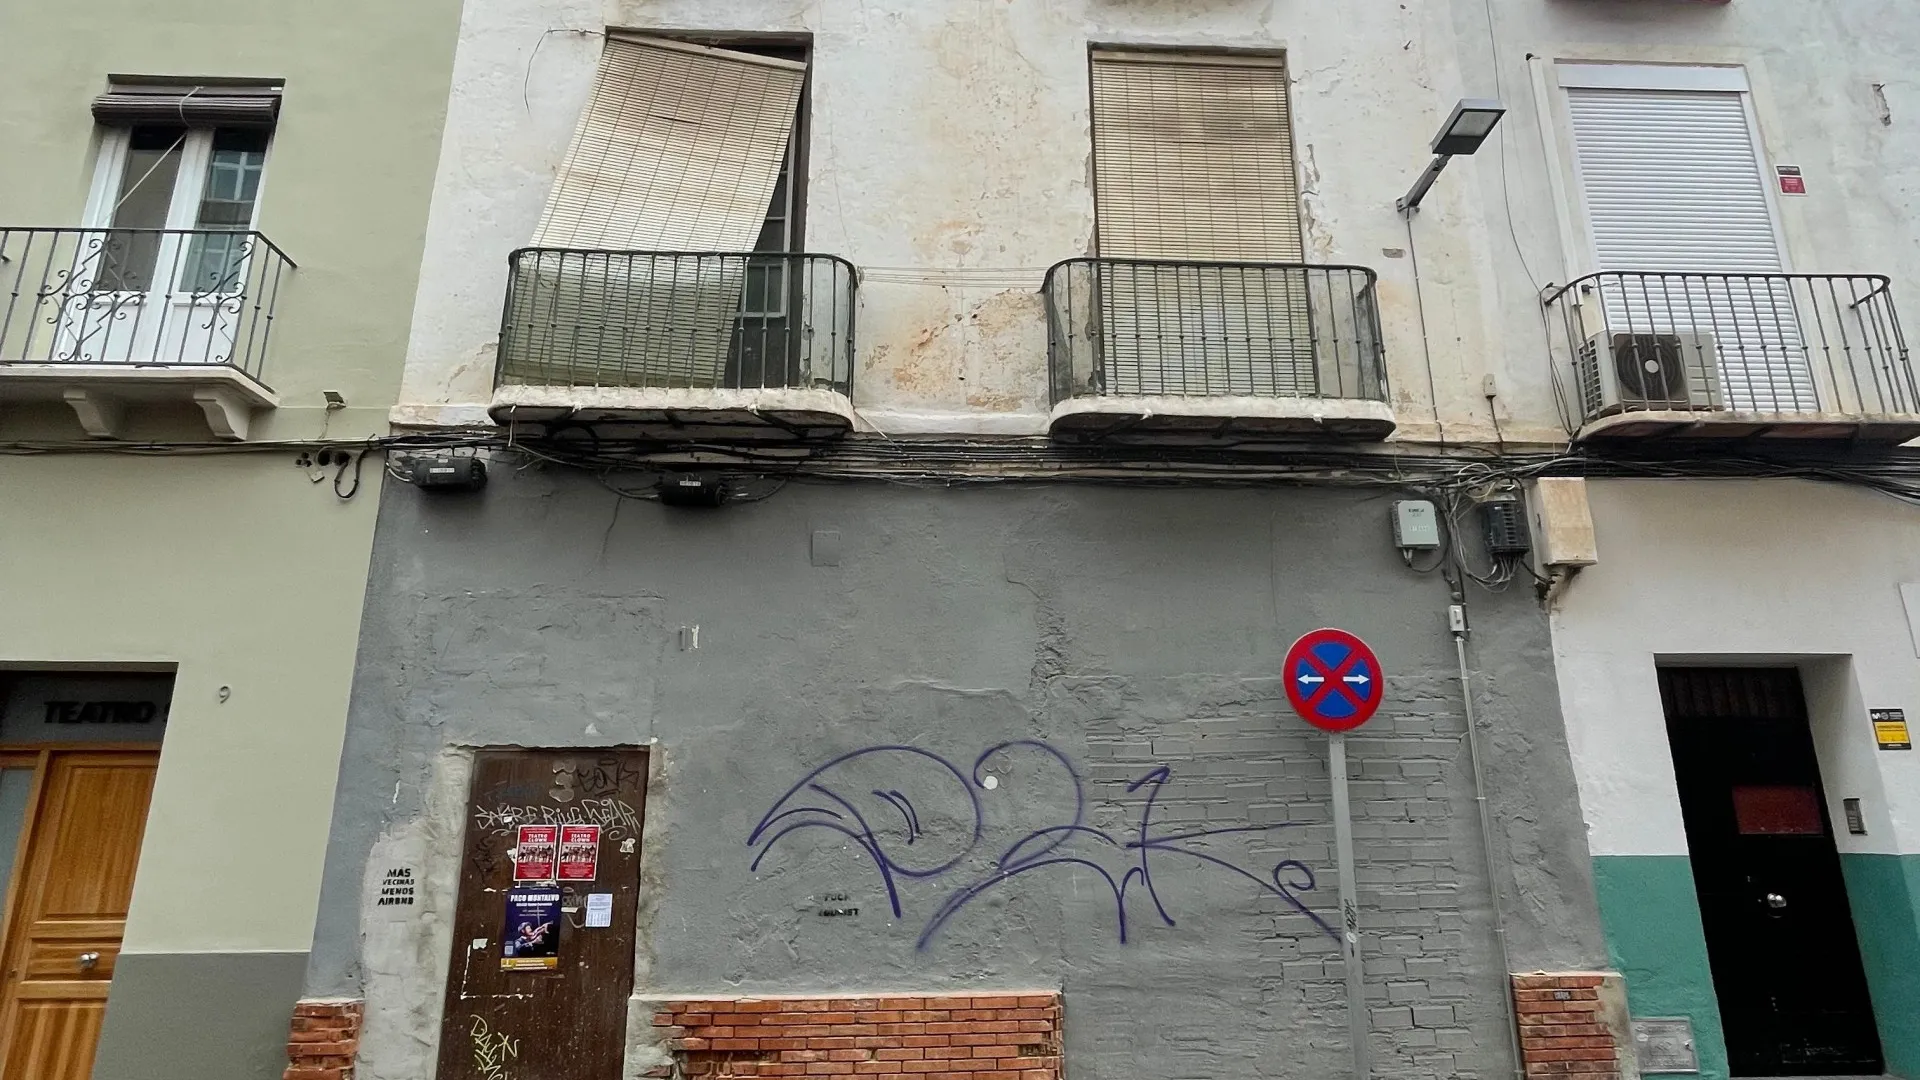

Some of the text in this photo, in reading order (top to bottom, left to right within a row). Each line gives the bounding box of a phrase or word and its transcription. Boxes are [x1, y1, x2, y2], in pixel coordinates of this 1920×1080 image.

[217, 685, 231, 704] 9
[44, 701, 157, 724] TEATRO
[381, 887, 414, 896] MENOS
[377, 897, 414, 906] AIRBNB
[510, 894, 527, 902] PACO
